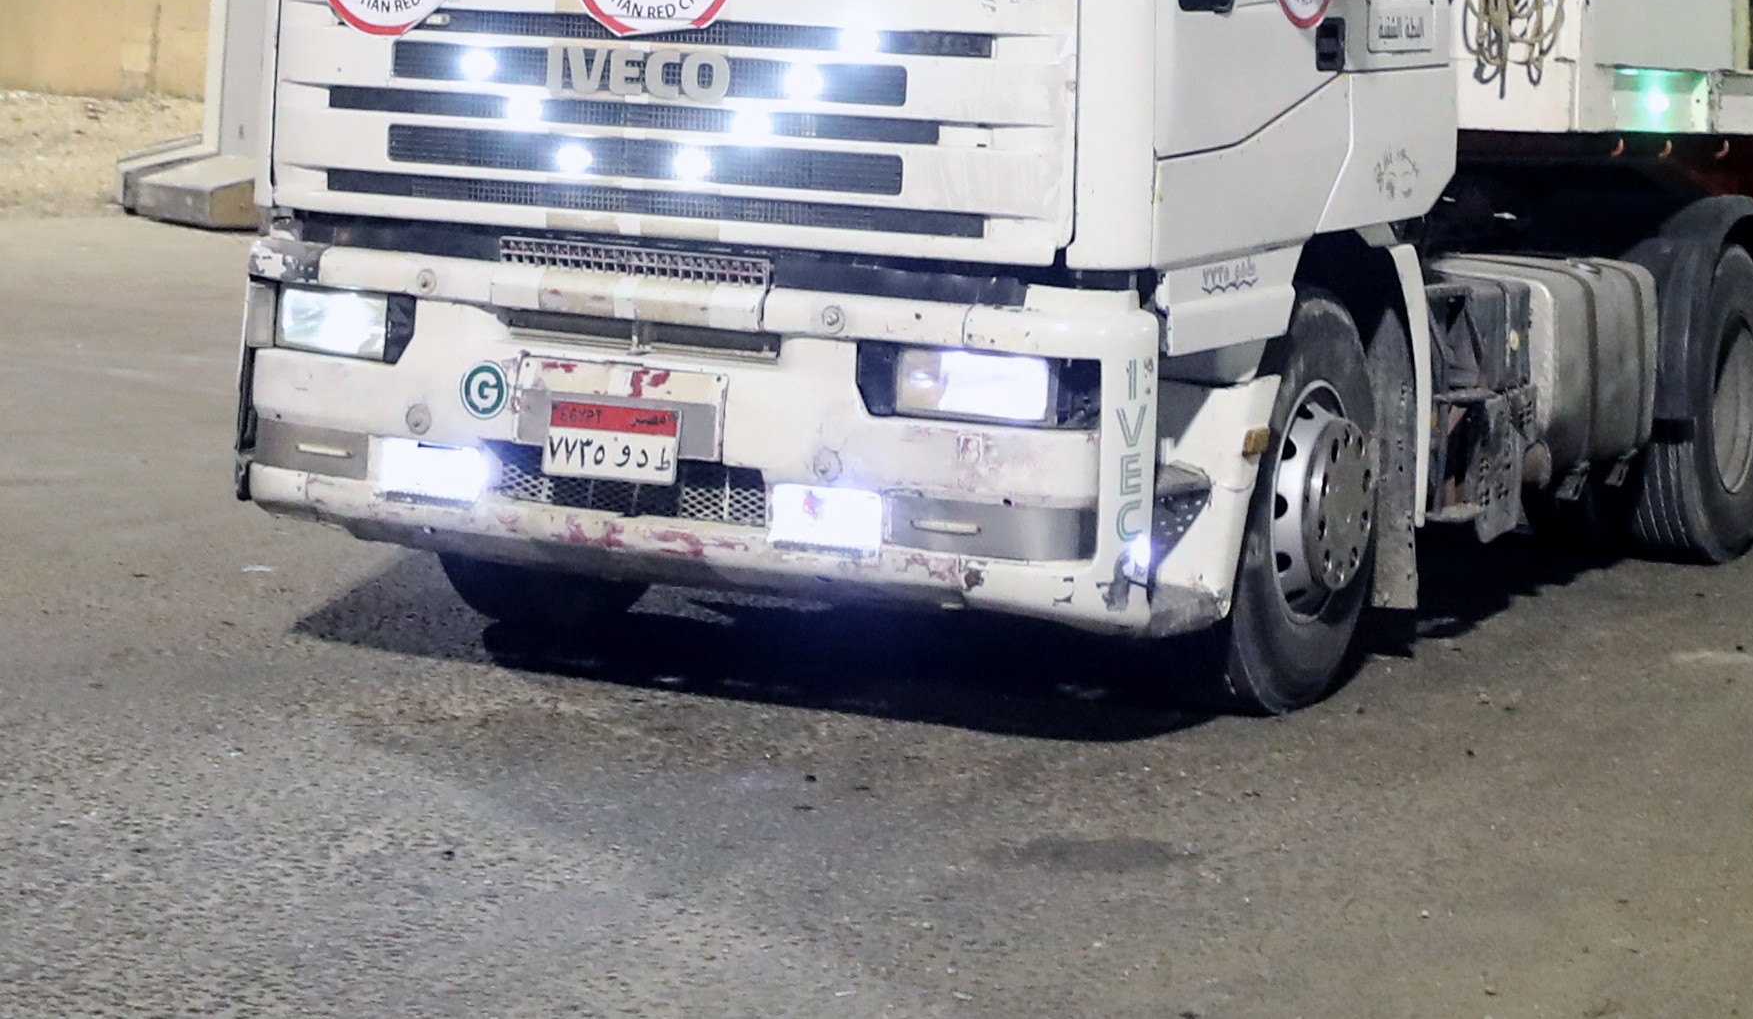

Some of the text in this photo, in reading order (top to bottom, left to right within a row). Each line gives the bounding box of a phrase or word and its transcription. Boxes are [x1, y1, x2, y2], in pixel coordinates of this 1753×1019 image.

[647, 3, 686, 19] RED
[546, 47, 730, 102] IVECO
[560, 407, 602, 424] EGYPT
[629, 414, 668, 429] مصر
[549, 435, 606, 468] ٧٧٣٥
